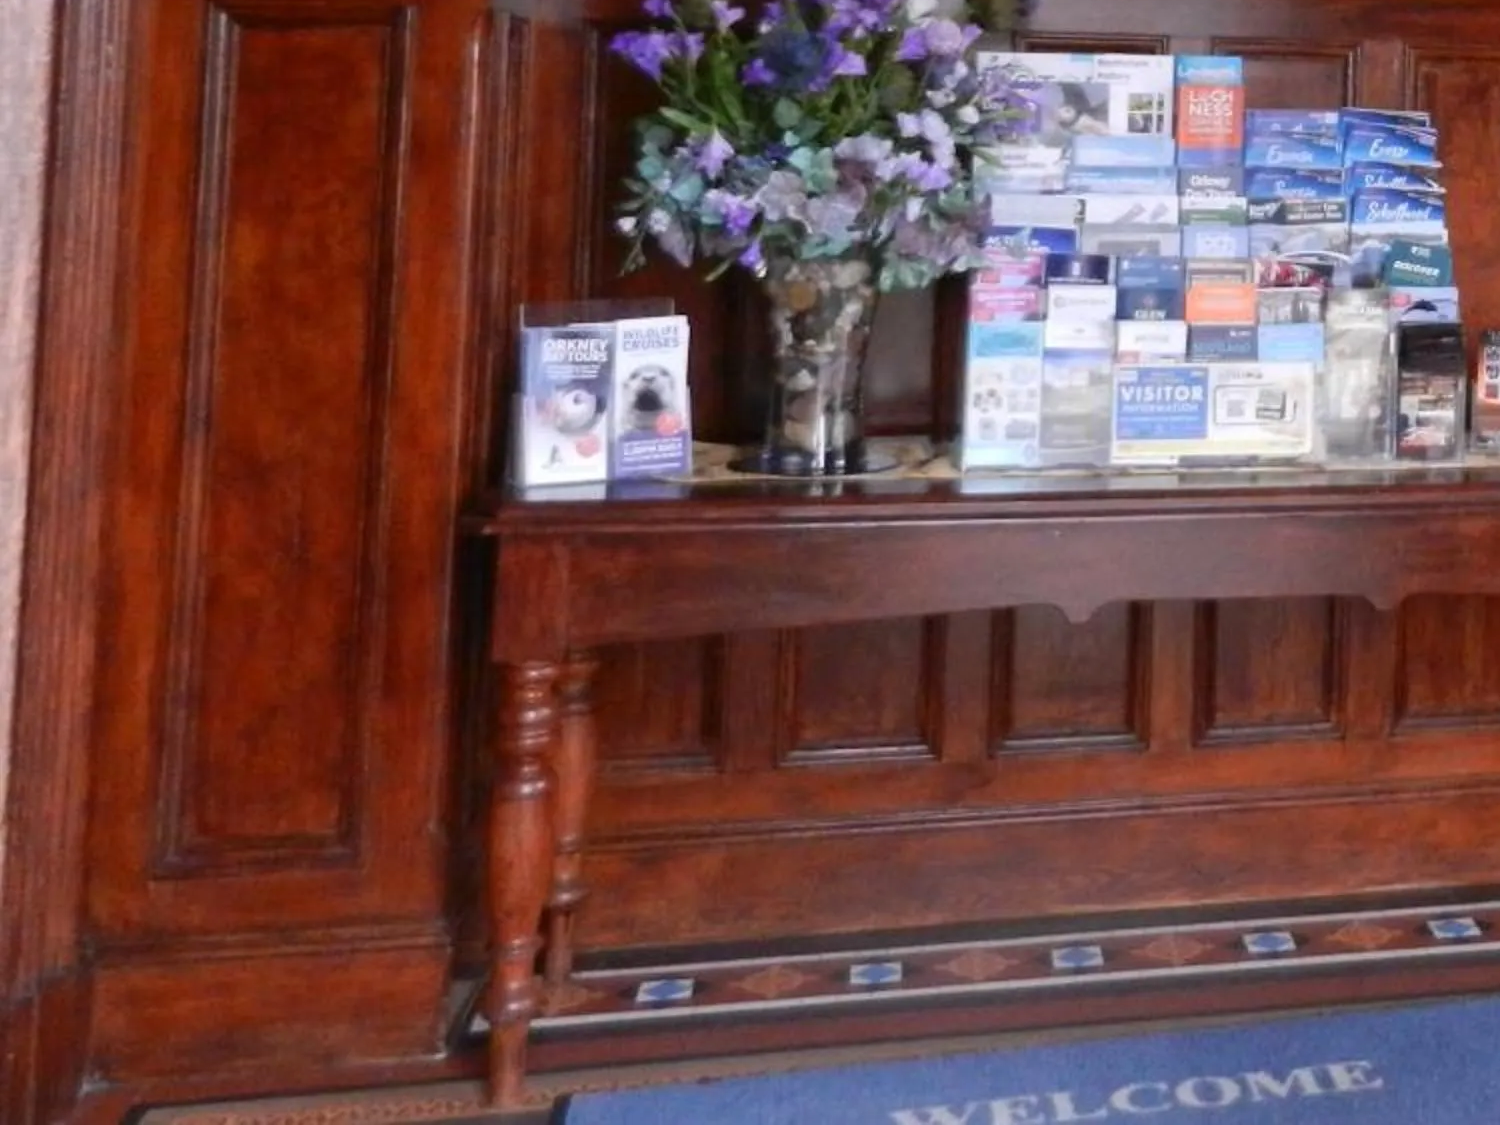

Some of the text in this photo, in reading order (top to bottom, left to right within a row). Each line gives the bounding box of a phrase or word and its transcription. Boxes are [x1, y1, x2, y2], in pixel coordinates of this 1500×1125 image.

[1188, 102, 1234, 117] NESS
[542, 338, 609, 352] ORKNEY
[622, 338, 680, 352] CRUISES
[568, 349, 609, 363] TOURS
[1119, 384, 1205, 402] VISITOR
[891, 1060, 1385, 1125] WELCOME
